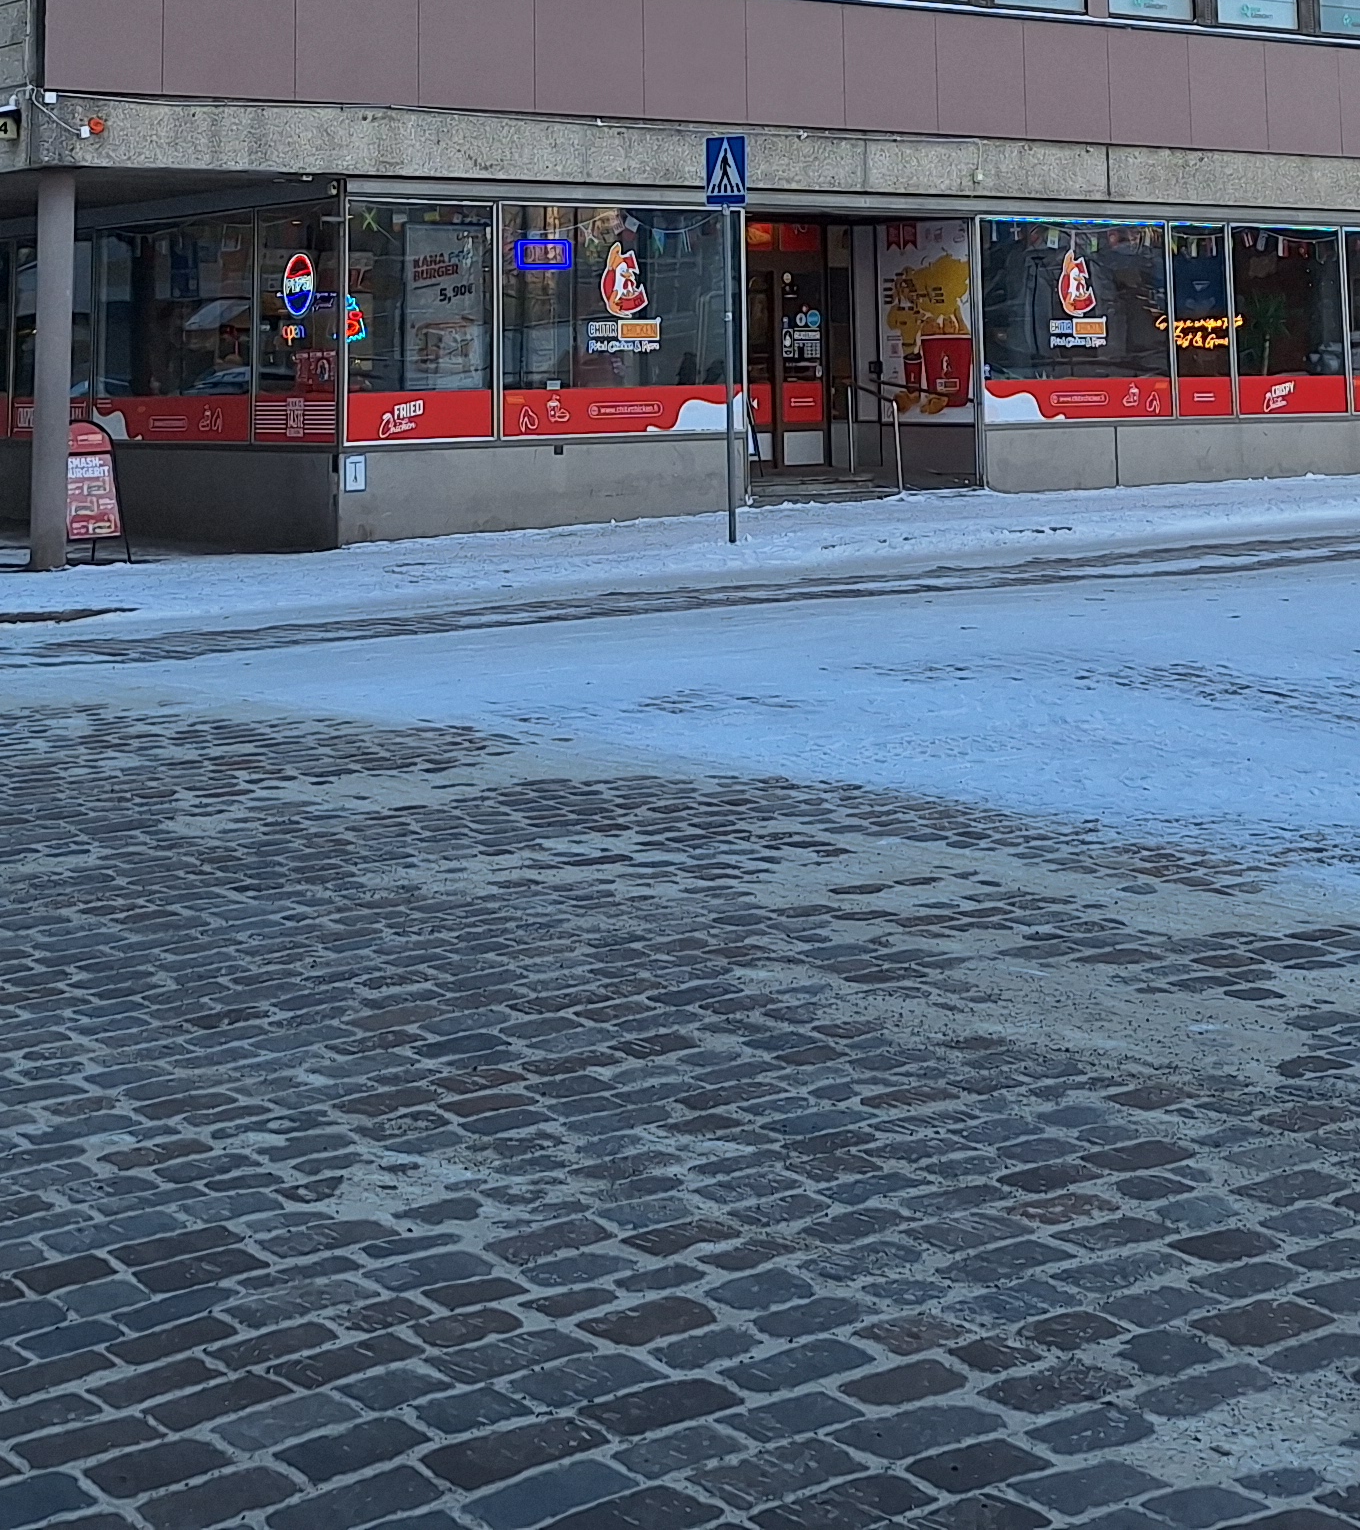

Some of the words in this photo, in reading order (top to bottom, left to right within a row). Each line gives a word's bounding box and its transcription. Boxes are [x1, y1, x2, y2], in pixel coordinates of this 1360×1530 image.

[0, 121, 8, 135] 4
[414, 264, 459, 282] BURGER
[286, 276, 311, 294] PEPSI
[439, 283, 475, 304] 5,90€
[282, 325, 305, 346] open
[286, 409, 304, 428] TASTE
[394, 400, 423, 420] FRIED
[379, 413, 416, 438] Chicken
